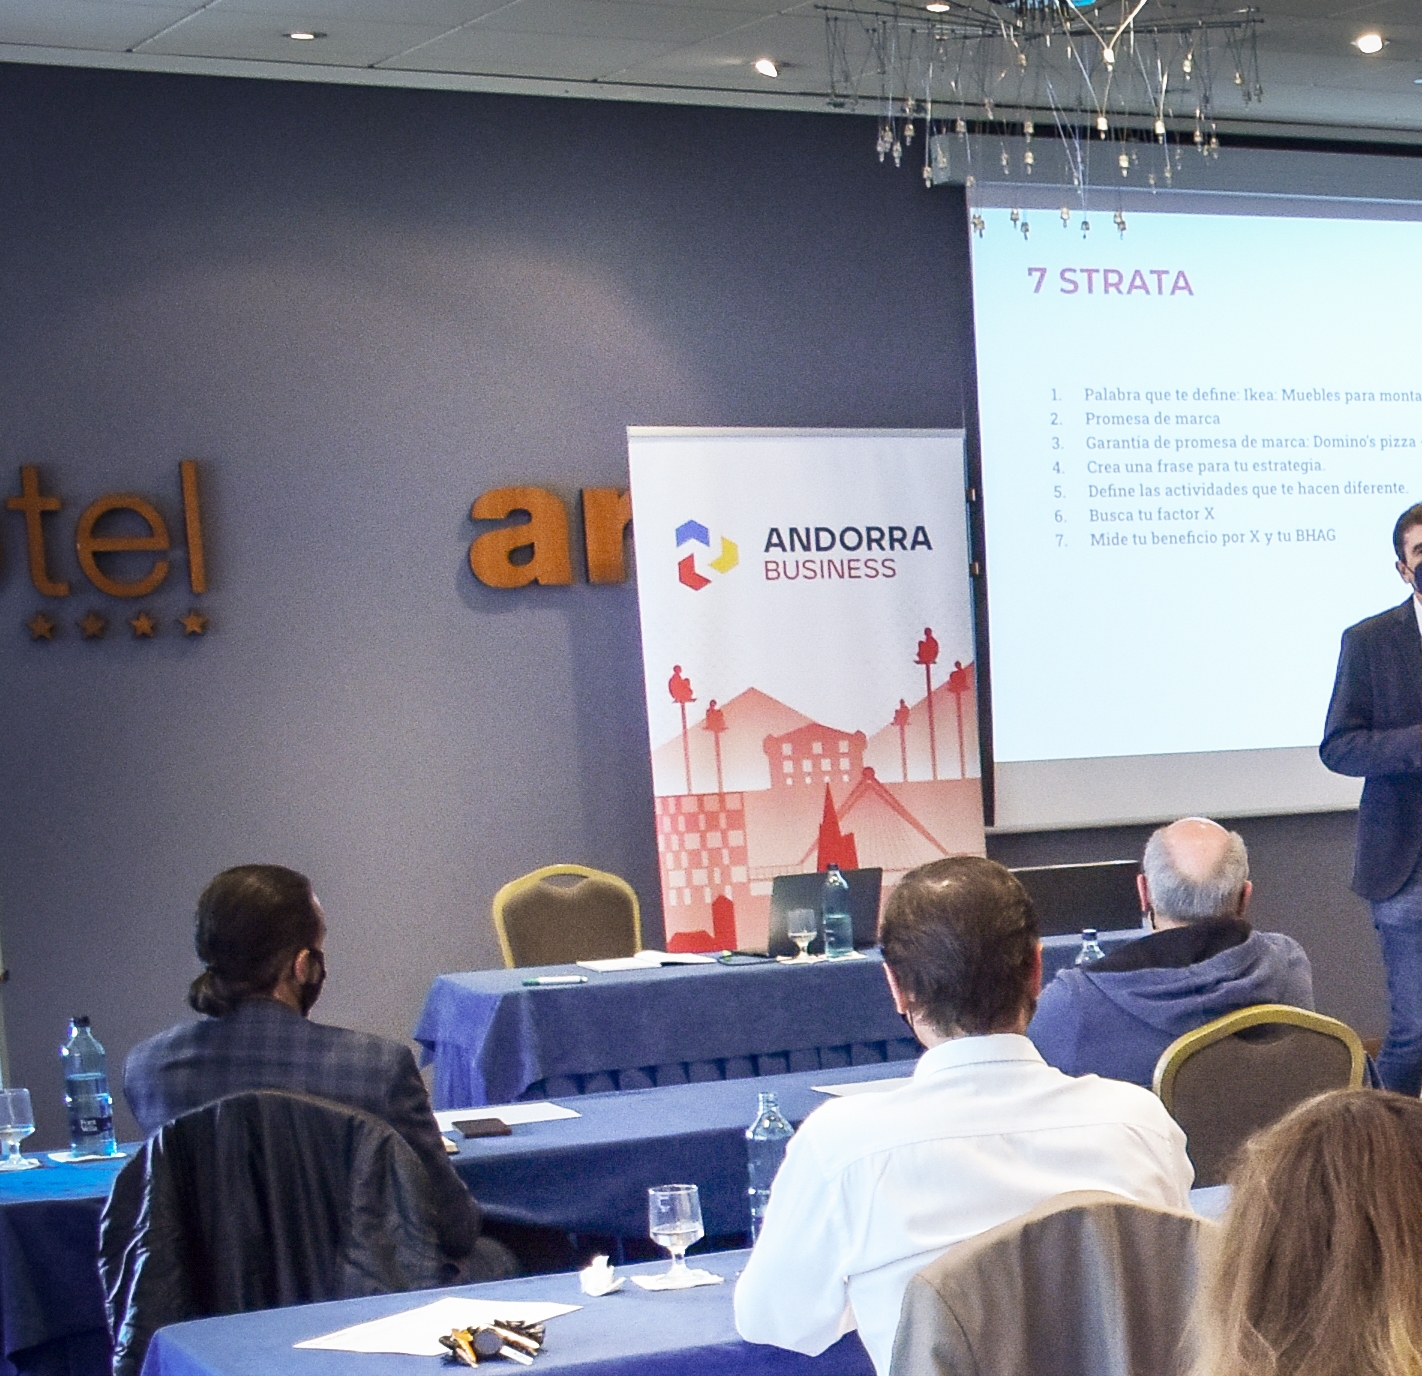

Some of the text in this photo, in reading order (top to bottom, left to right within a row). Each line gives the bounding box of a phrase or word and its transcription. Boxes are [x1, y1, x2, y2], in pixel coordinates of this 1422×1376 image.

[1026, 267, 1195, 297] 7 STRATA
[1051, 387, 1063, 402] 1.
[1084, 386, 1141, 402] Palabra
[1144, 390, 1172, 405] que
[1175, 388, 1189, 402] te
[1192, 386, 1241, 402] define:
[1243, 387, 1278, 402] Ikea:
[1281, 387, 1341, 402] Muebles
[1344, 391, 1376, 405] para
[1049, 410, 1221, 426] 2. Promesa de marca
[1051, 435, 1065, 450] 3.
[1153, 434, 1171, 449] de
[1174, 437, 1238, 453] promesa
[1240, 434, 1258, 449] de
[1260, 437, 1310, 449] marca:
[1312, 434, 1377, 449] Domino's
[1379, 434, 1417, 452] pizza
[1052, 457, 1327, 477] 4. Crea una frase para tu estrategia.
[1053, 480, 1410, 499] 5. Define las actividades que te hacen diferente.
[1054, 506, 1216, 524] 6. Busca tu factor X
[0, 458, 208, 598] tel
[1054, 527, 1337, 548] 7. Mide tu beneficio por X y tu BHAG
[764, 525, 933, 553] ANDORRA
[764, 557, 897, 581] BUSINESS
